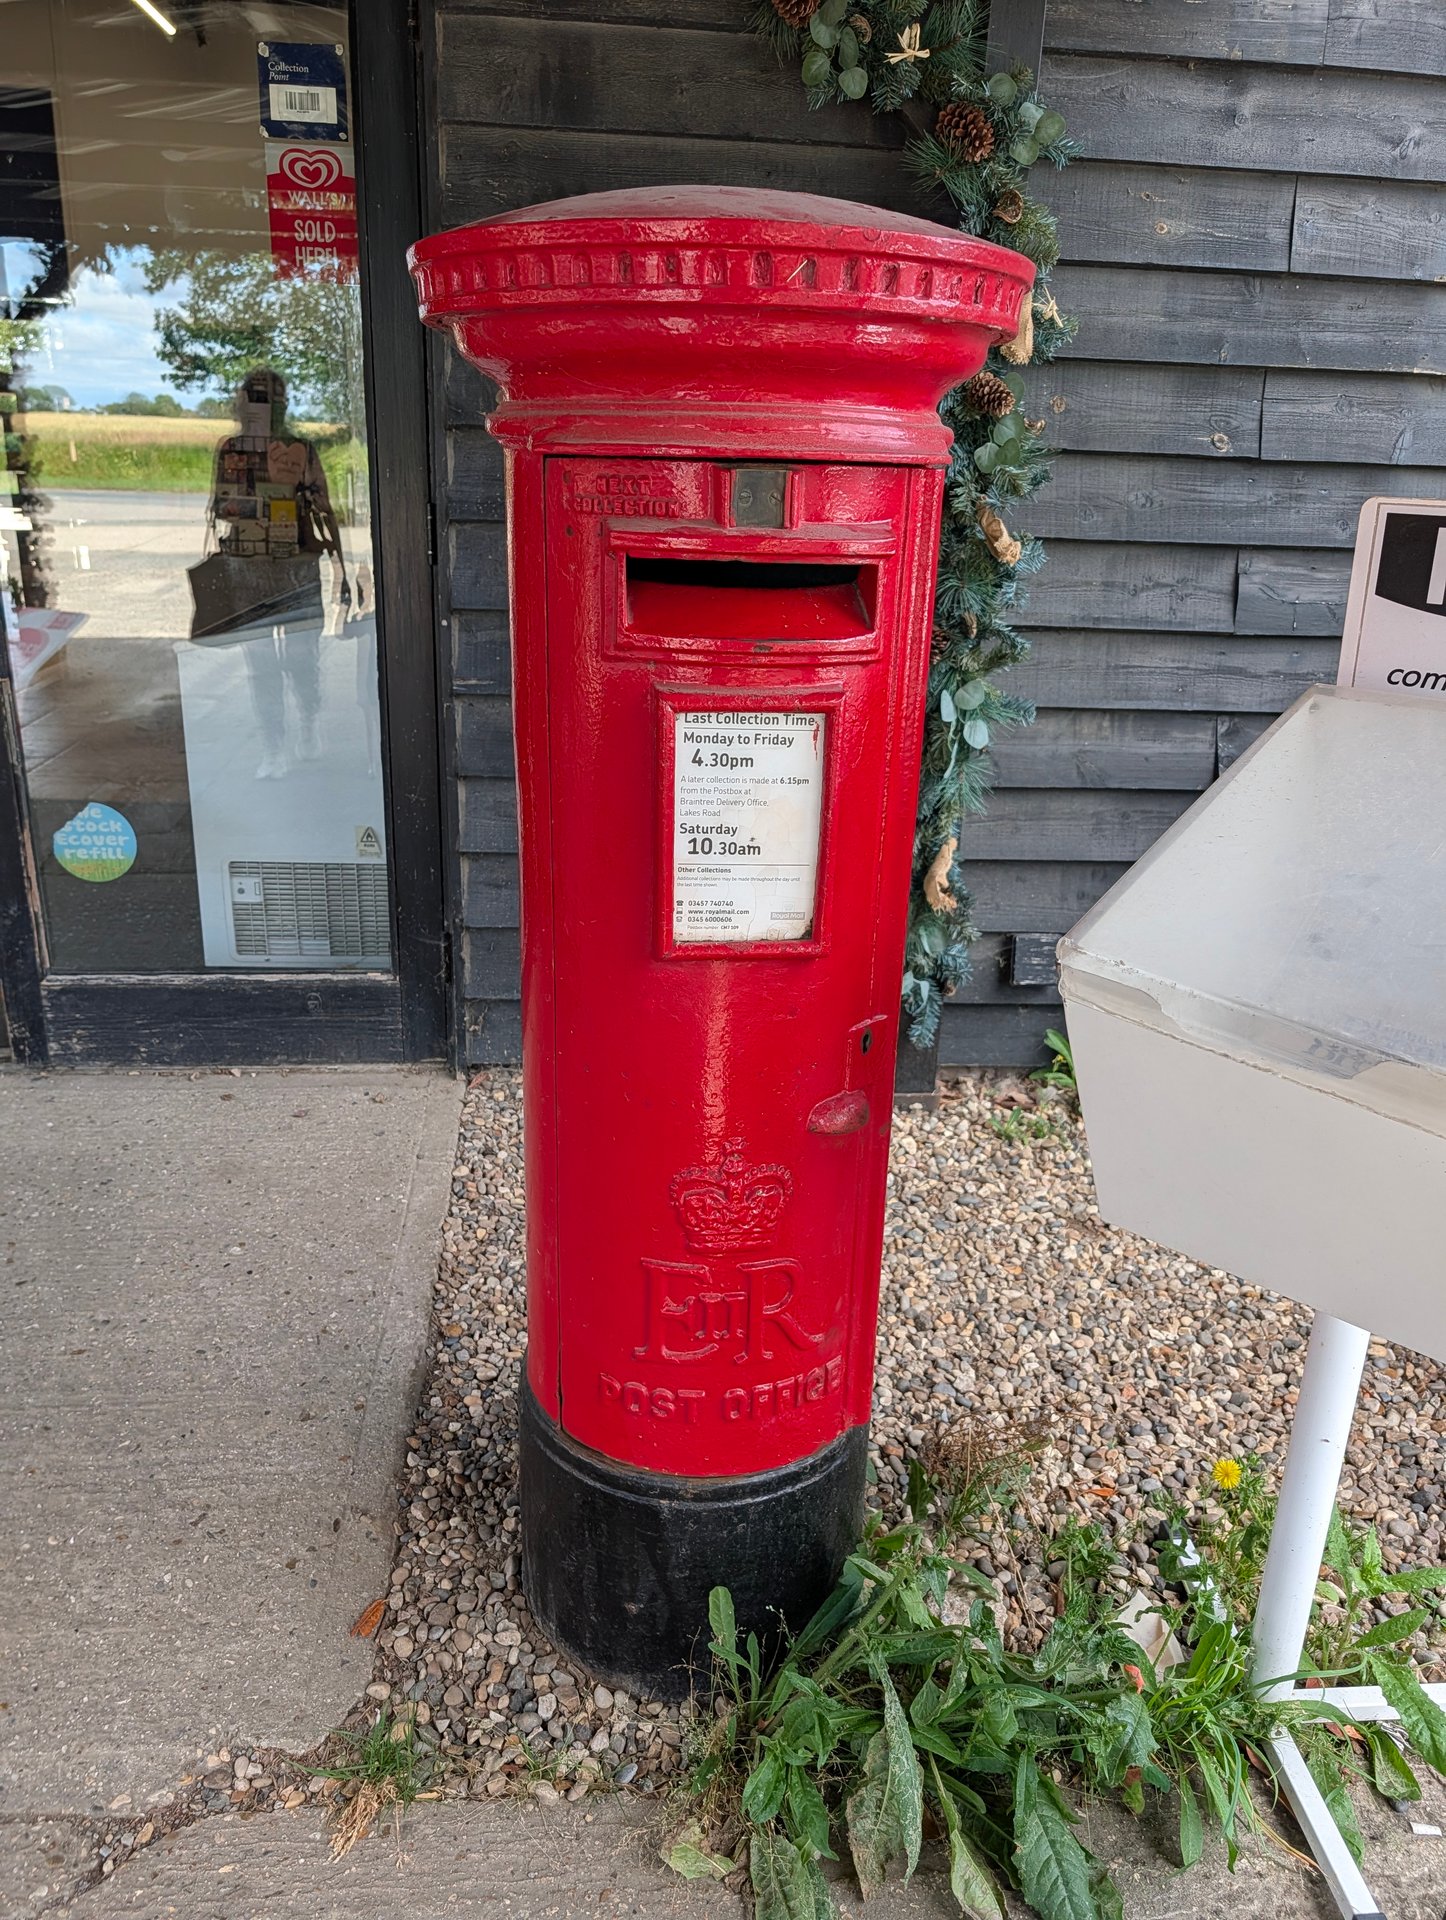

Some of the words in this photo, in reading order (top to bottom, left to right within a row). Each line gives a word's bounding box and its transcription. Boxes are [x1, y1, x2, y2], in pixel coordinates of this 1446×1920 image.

[268, 61, 309, 73] Collection
[269, 71, 289, 81] Point
[294, 219, 336, 243] SOLD
[574, 497, 680, 518] COLLECTION
[684, 712, 713, 724] Last
[715, 712, 780, 726] Collection
[683, 731, 735, 747] Monday
[737, 734, 751, 745] to
[754, 733, 795, 748] Friday
[691, 748, 754, 770] 4.30pm
[706, 776, 741, 784] collection
[742, 776, 748, 784] is
[749, 776, 769, 785] made
[771, 777, 779, 785] at
[780, 776, 810, 786] 6.15pm
[680, 787, 699, 795] from
[700, 787, 712, 795] the
[713, 787, 742, 796] Postbox
[743, 788, 752, 796] at
[680, 798, 715, 806] Braintree
[716, 798, 745, 808] Delivery
[679, 808, 701, 817] Lakes
[702, 808, 721, 817] Road
[679, 822, 738, 837] Saturday
[57, 833, 129, 846] Ecover
[687, 836, 761, 856] 10.30am
[64, 847, 126, 860] refill
[697, 866, 732, 874] Collections
[599, 1372, 706, 1422] POST
[722, 1355, 844, 1421] OFFICE
